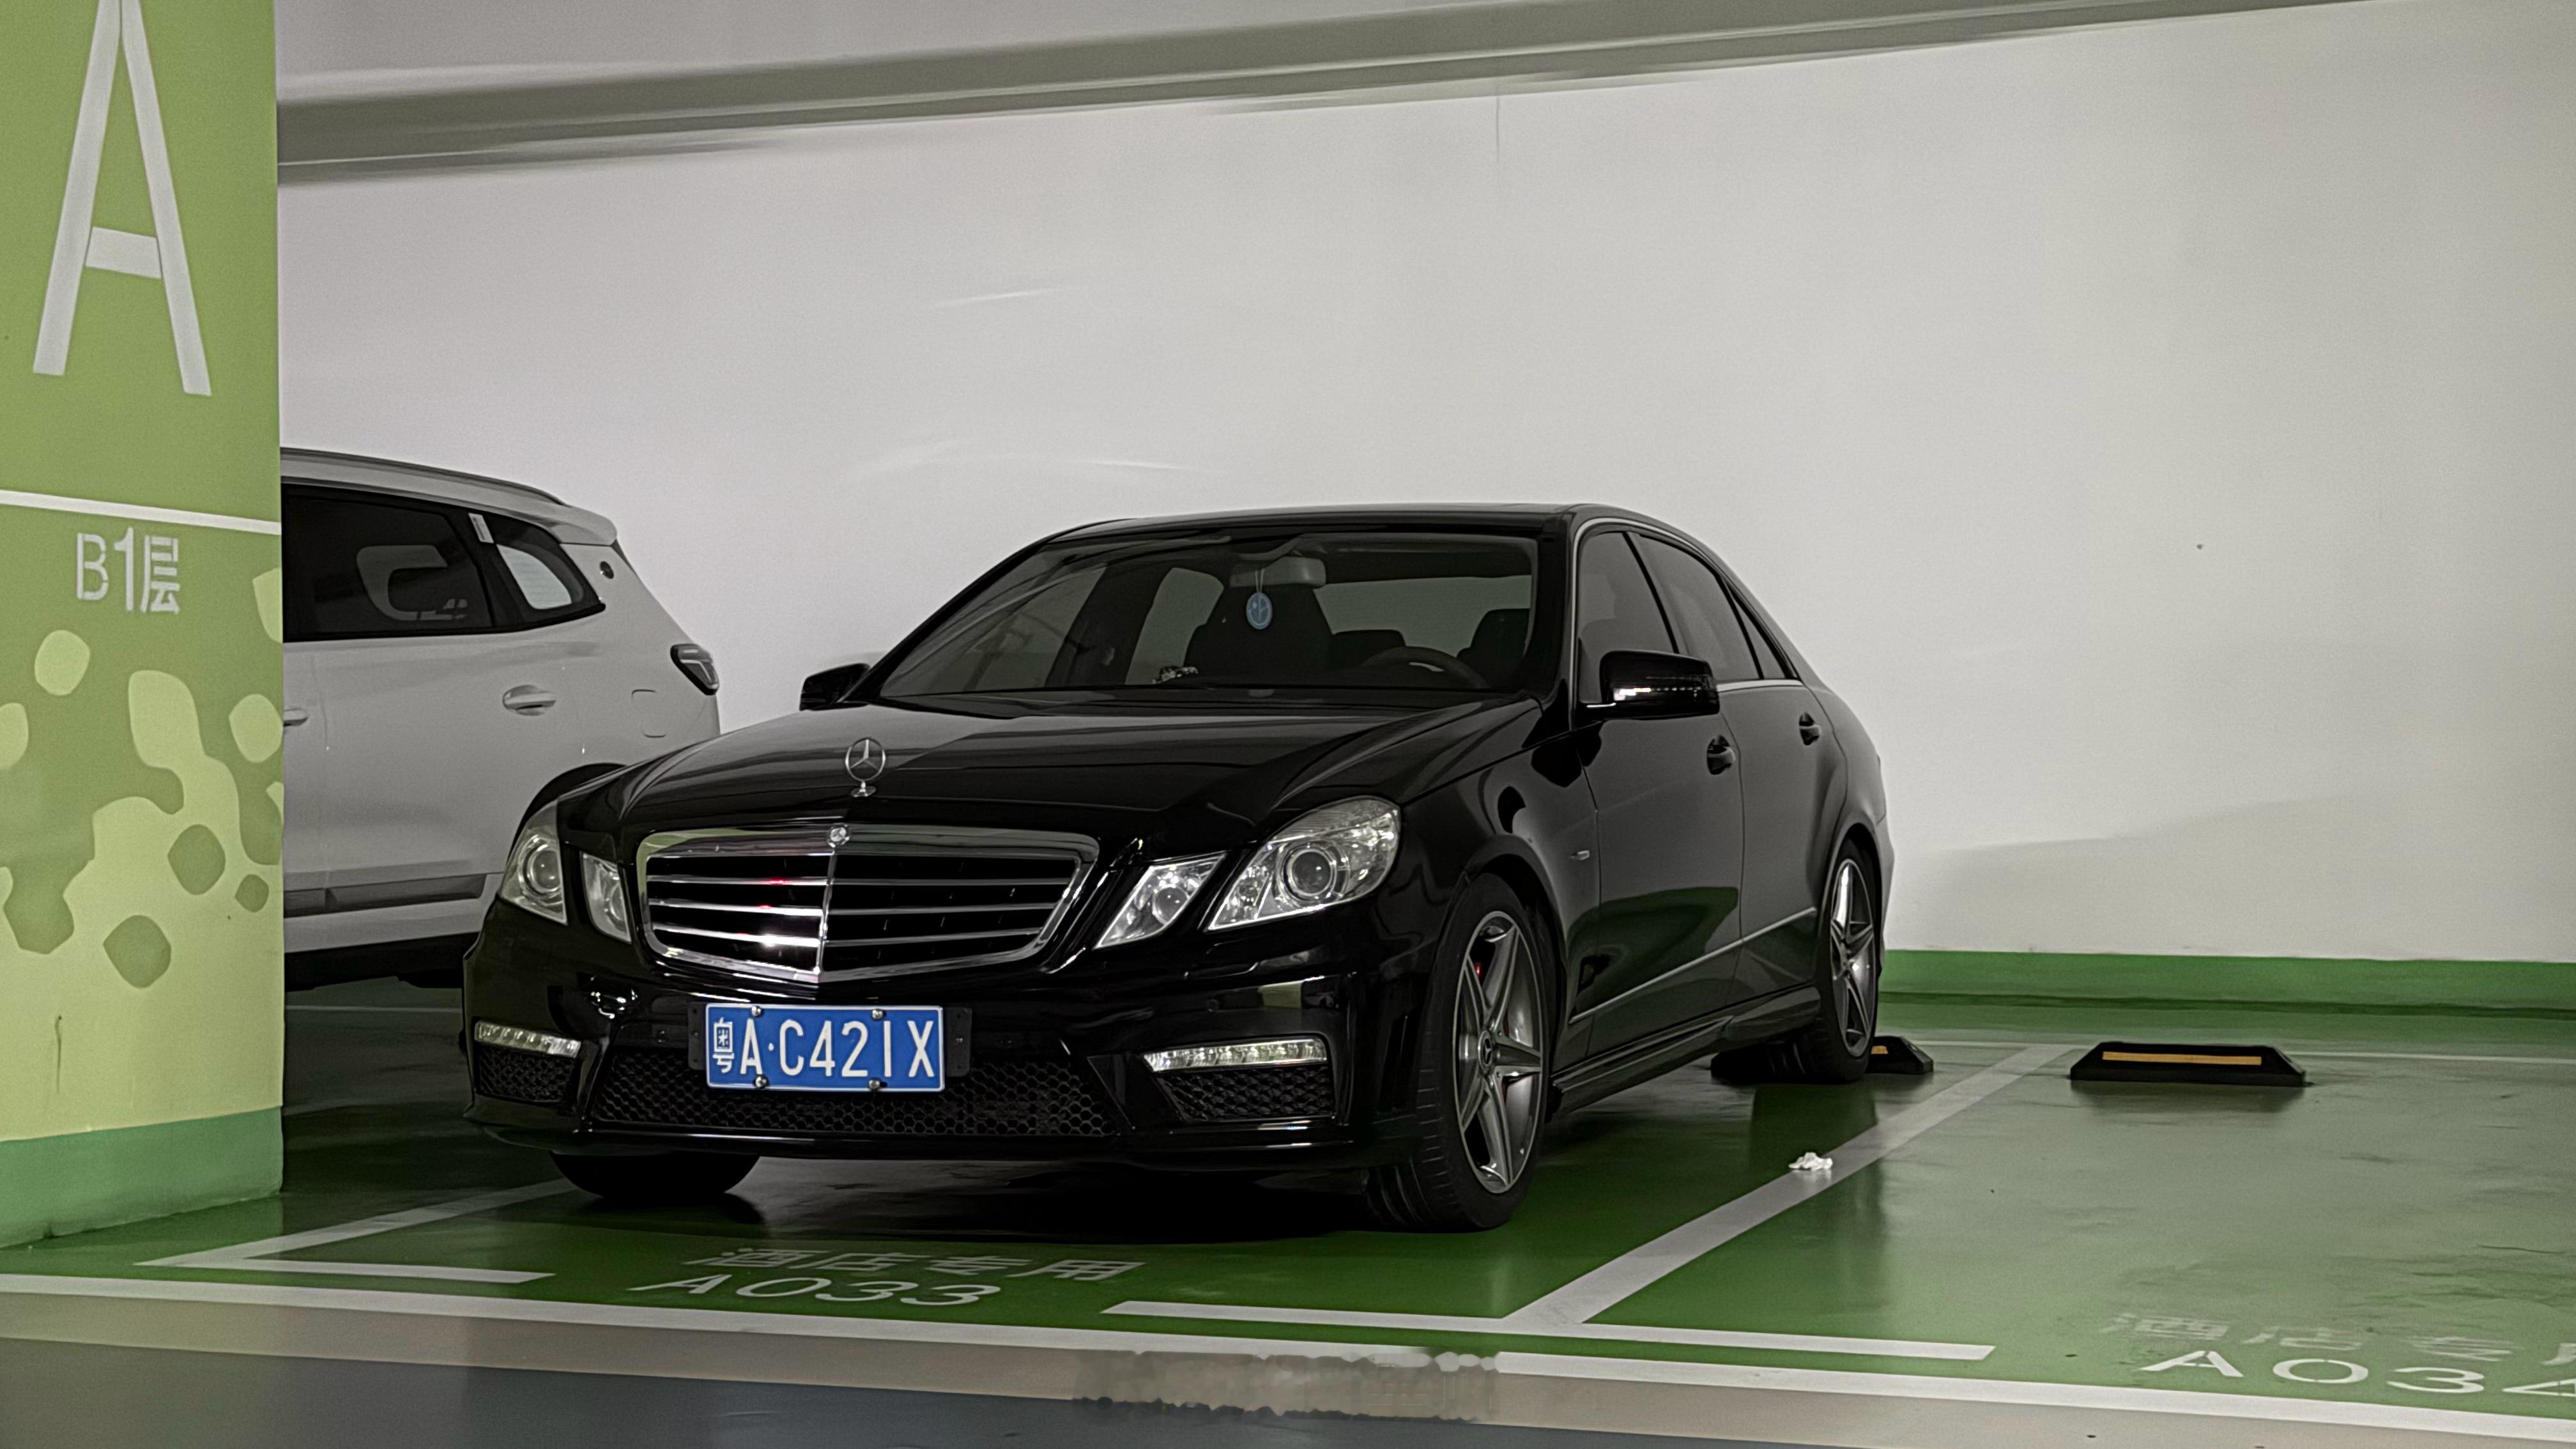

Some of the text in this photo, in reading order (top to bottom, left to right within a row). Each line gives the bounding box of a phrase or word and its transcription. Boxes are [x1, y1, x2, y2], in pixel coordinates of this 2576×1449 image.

[33, 0, 212, 397] A
[75, 527, 180, 614] B1层
[627, 1274, 1001, 1306] A033
[682, 1248, 1146, 1280] 酒店专用
